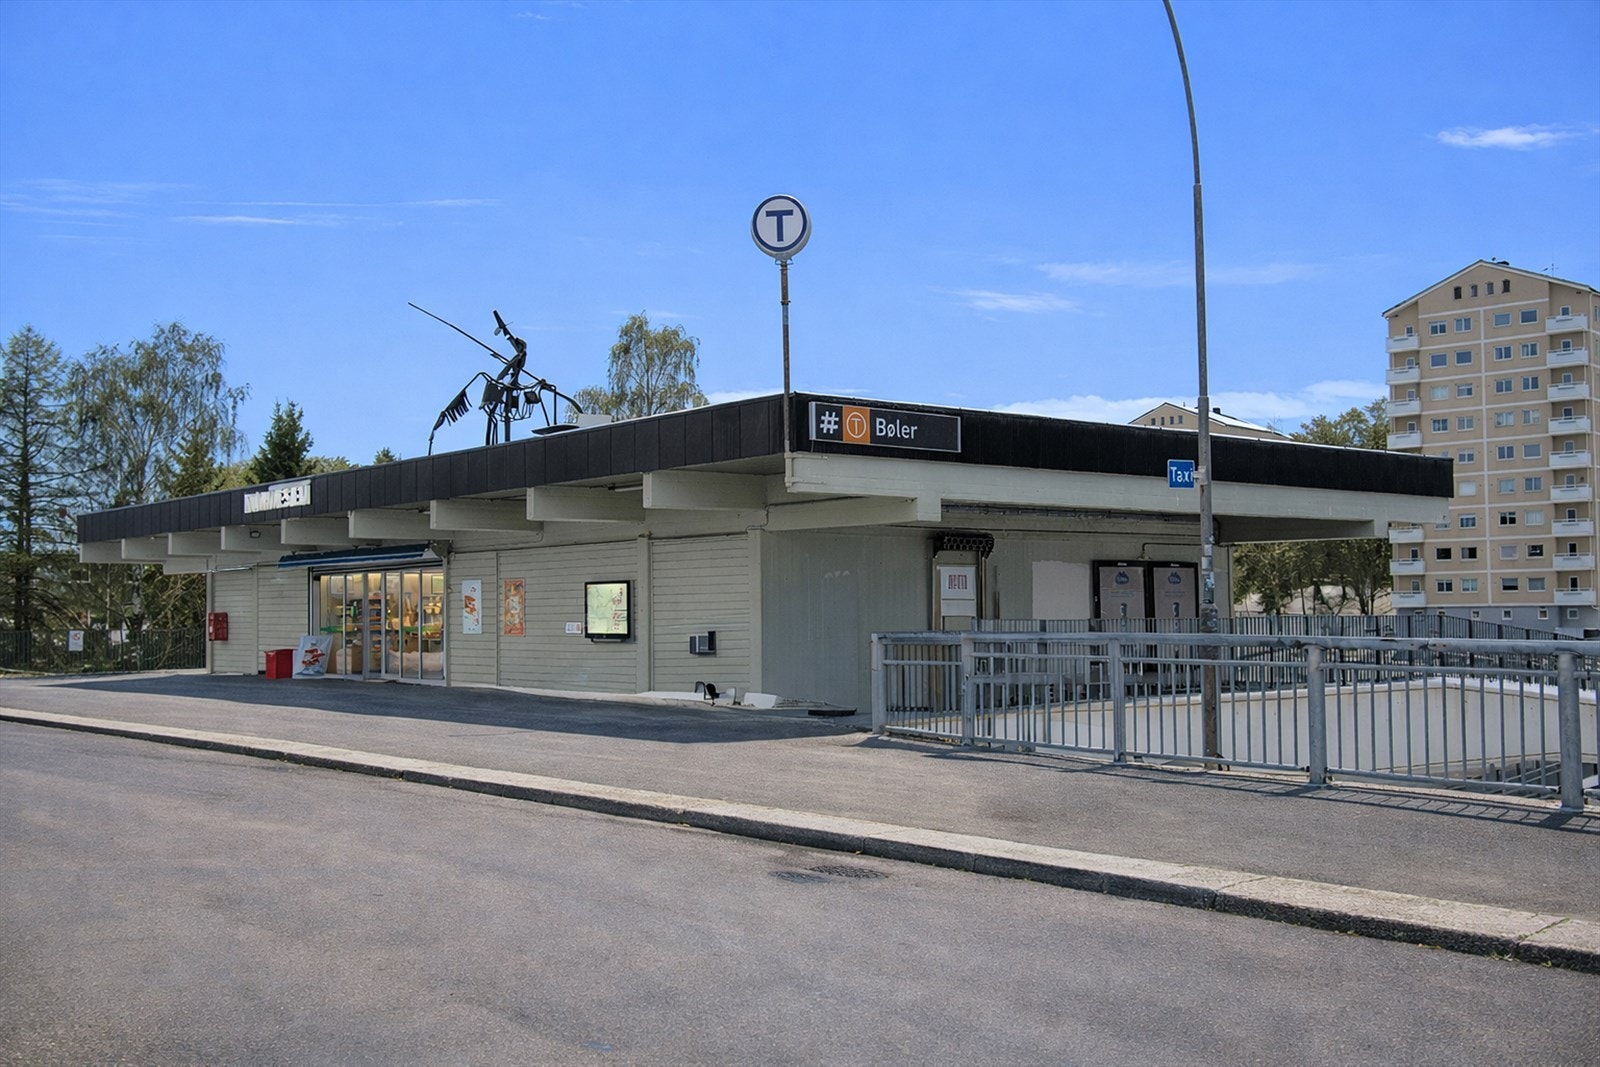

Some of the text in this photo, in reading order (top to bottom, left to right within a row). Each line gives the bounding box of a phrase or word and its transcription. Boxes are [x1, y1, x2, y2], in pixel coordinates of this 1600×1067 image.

[765, 209, 794, 243] T
[876, 417, 918, 439] Bøler
[1170, 466, 1194, 482] Taxi
